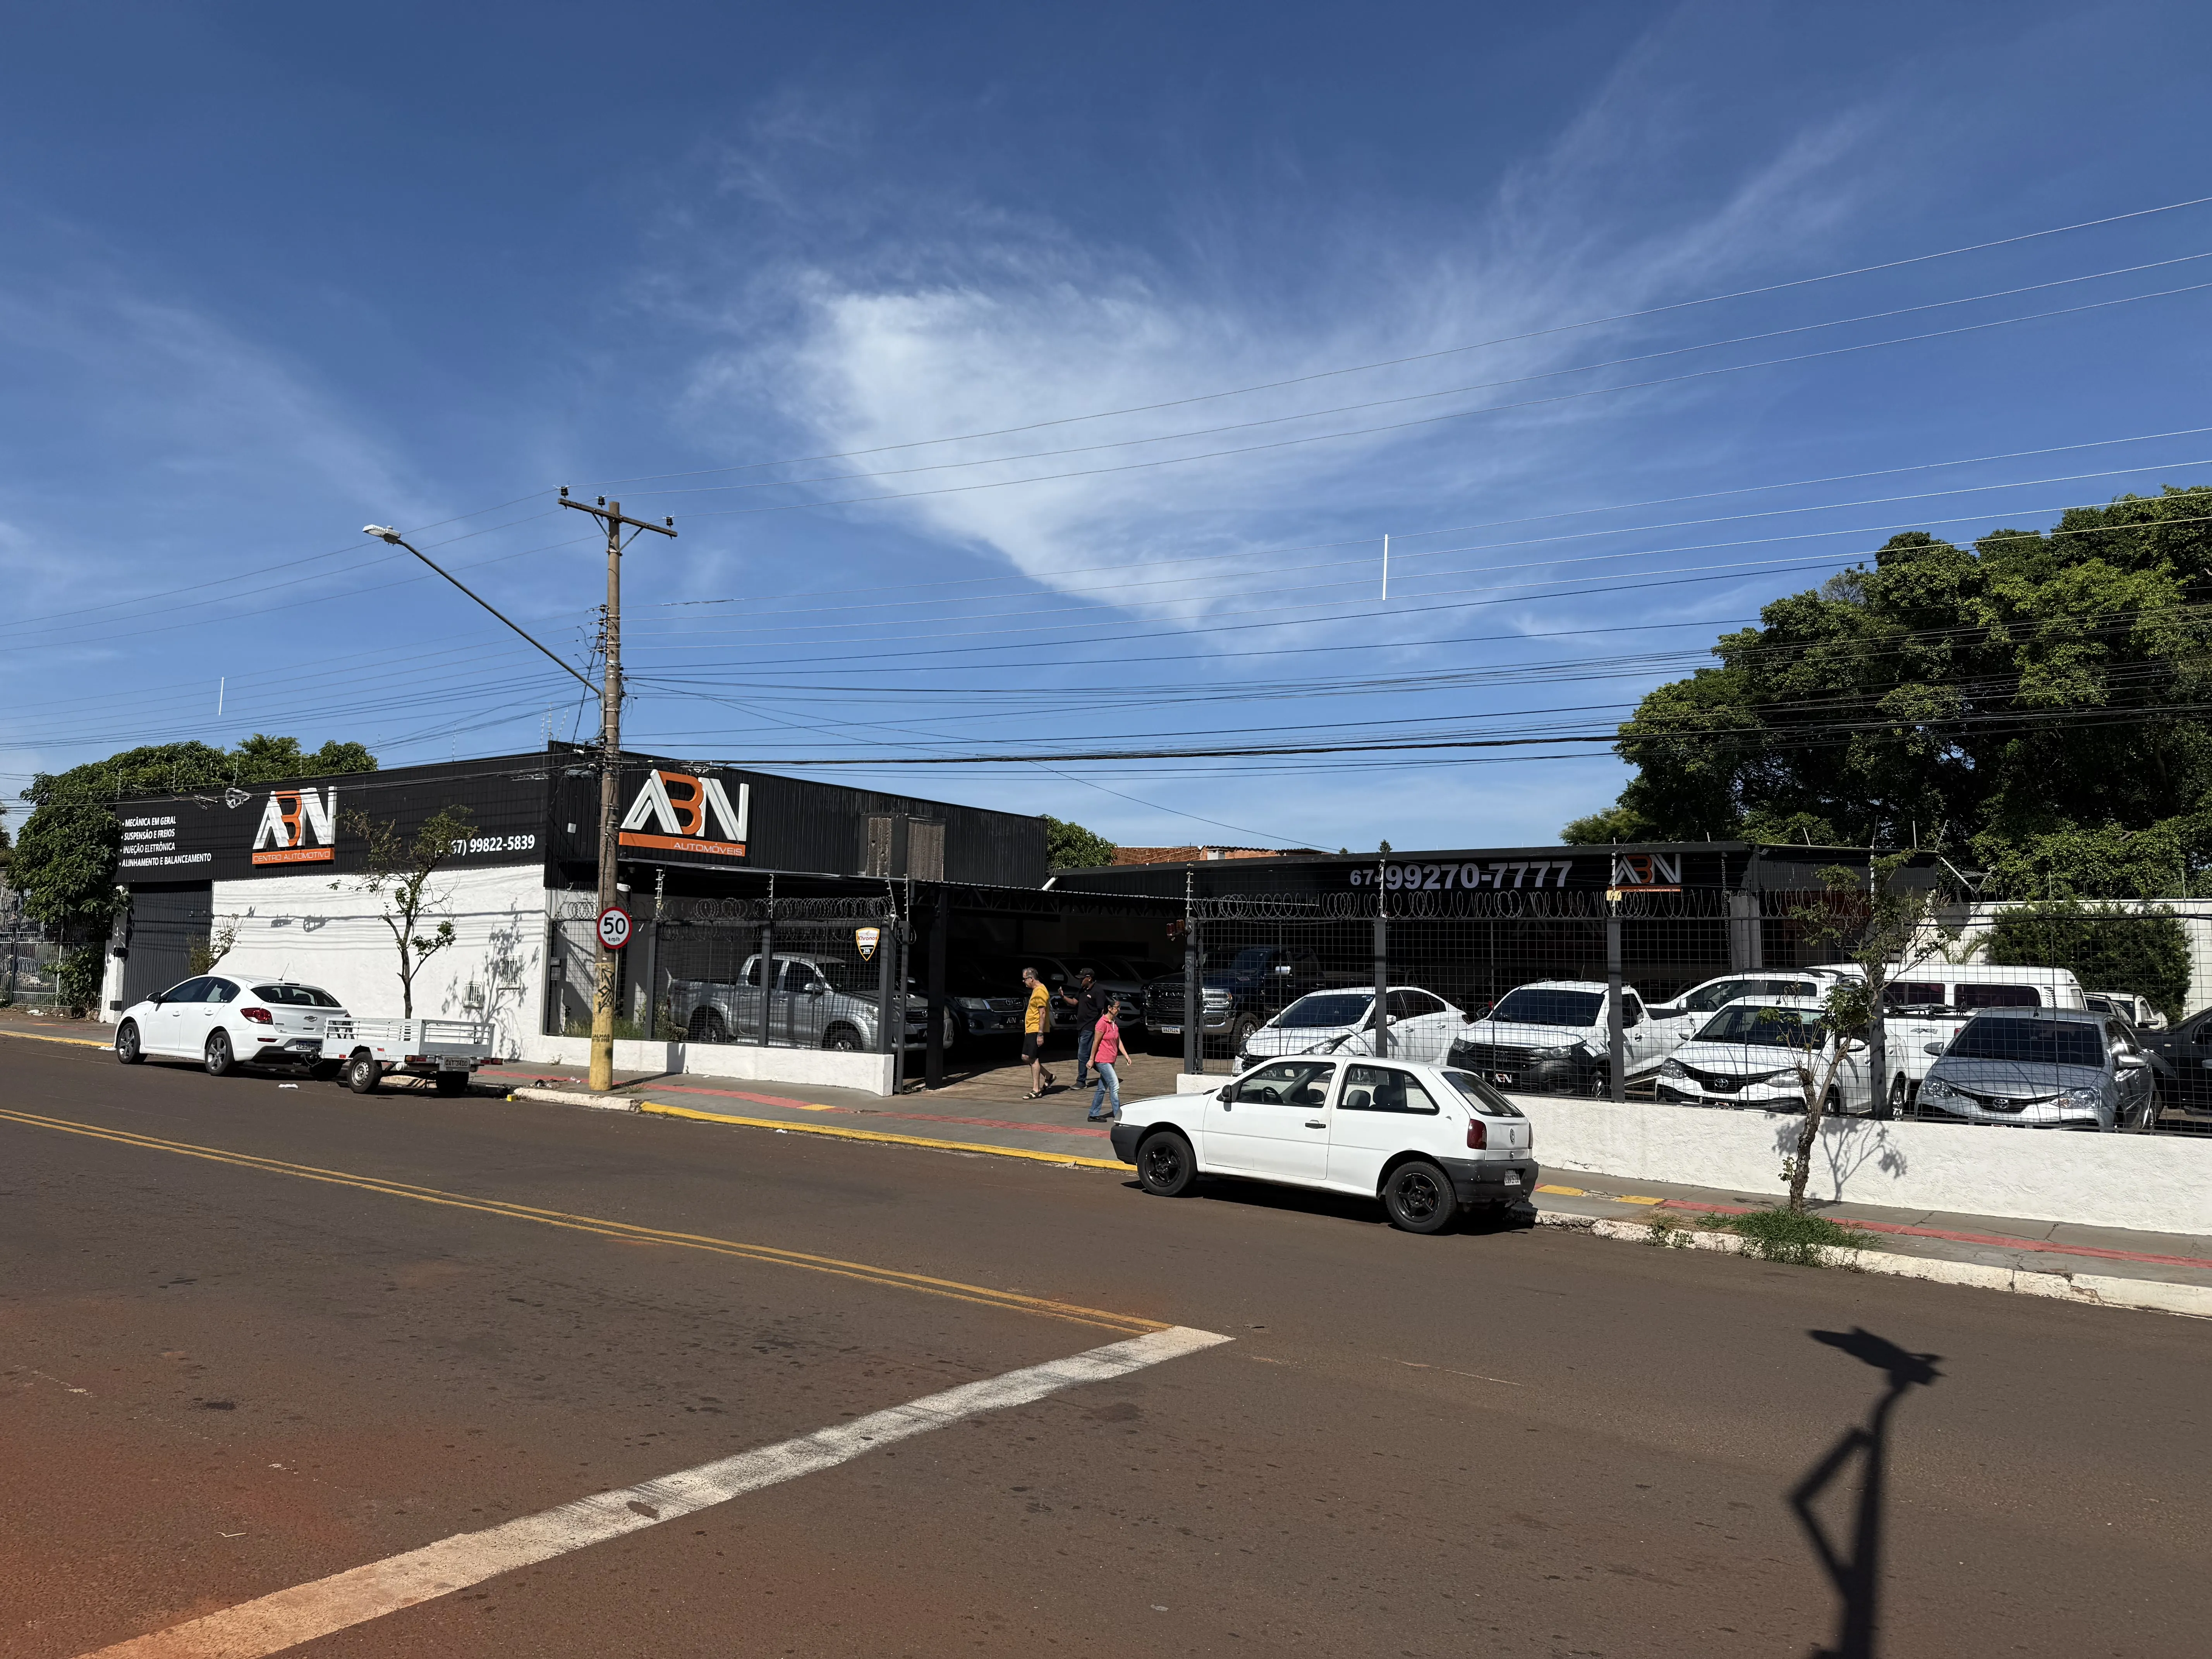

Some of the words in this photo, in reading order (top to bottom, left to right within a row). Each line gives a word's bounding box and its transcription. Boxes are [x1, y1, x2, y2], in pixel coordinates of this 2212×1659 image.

[125, 816, 151, 827] MECÂNICA
[151, 817, 160, 826] EM
[160, 816, 176, 825] GERAL
[124, 829, 153, 840] SUSPENSÃO
[153, 831, 157, 839] E
[158, 829, 175, 838] FREIOS
[123, 843, 144, 855] INJEÇÃO
[145, 842, 175, 853] ELETRÔNICA
[470, 834, 535, 853] 99822-5839
[673, 842, 743, 855] AUTOMÓVEIS
[122, 857, 159, 867] ALINHAMENTO
[160, 857, 163, 865] E
[164, 853, 211, 865] BALANCEAMENTO
[253, 854, 282, 862] CENTRO
[283, 851, 330, 860] AUTOMOTIVO
[604, 917, 626, 934] 50
